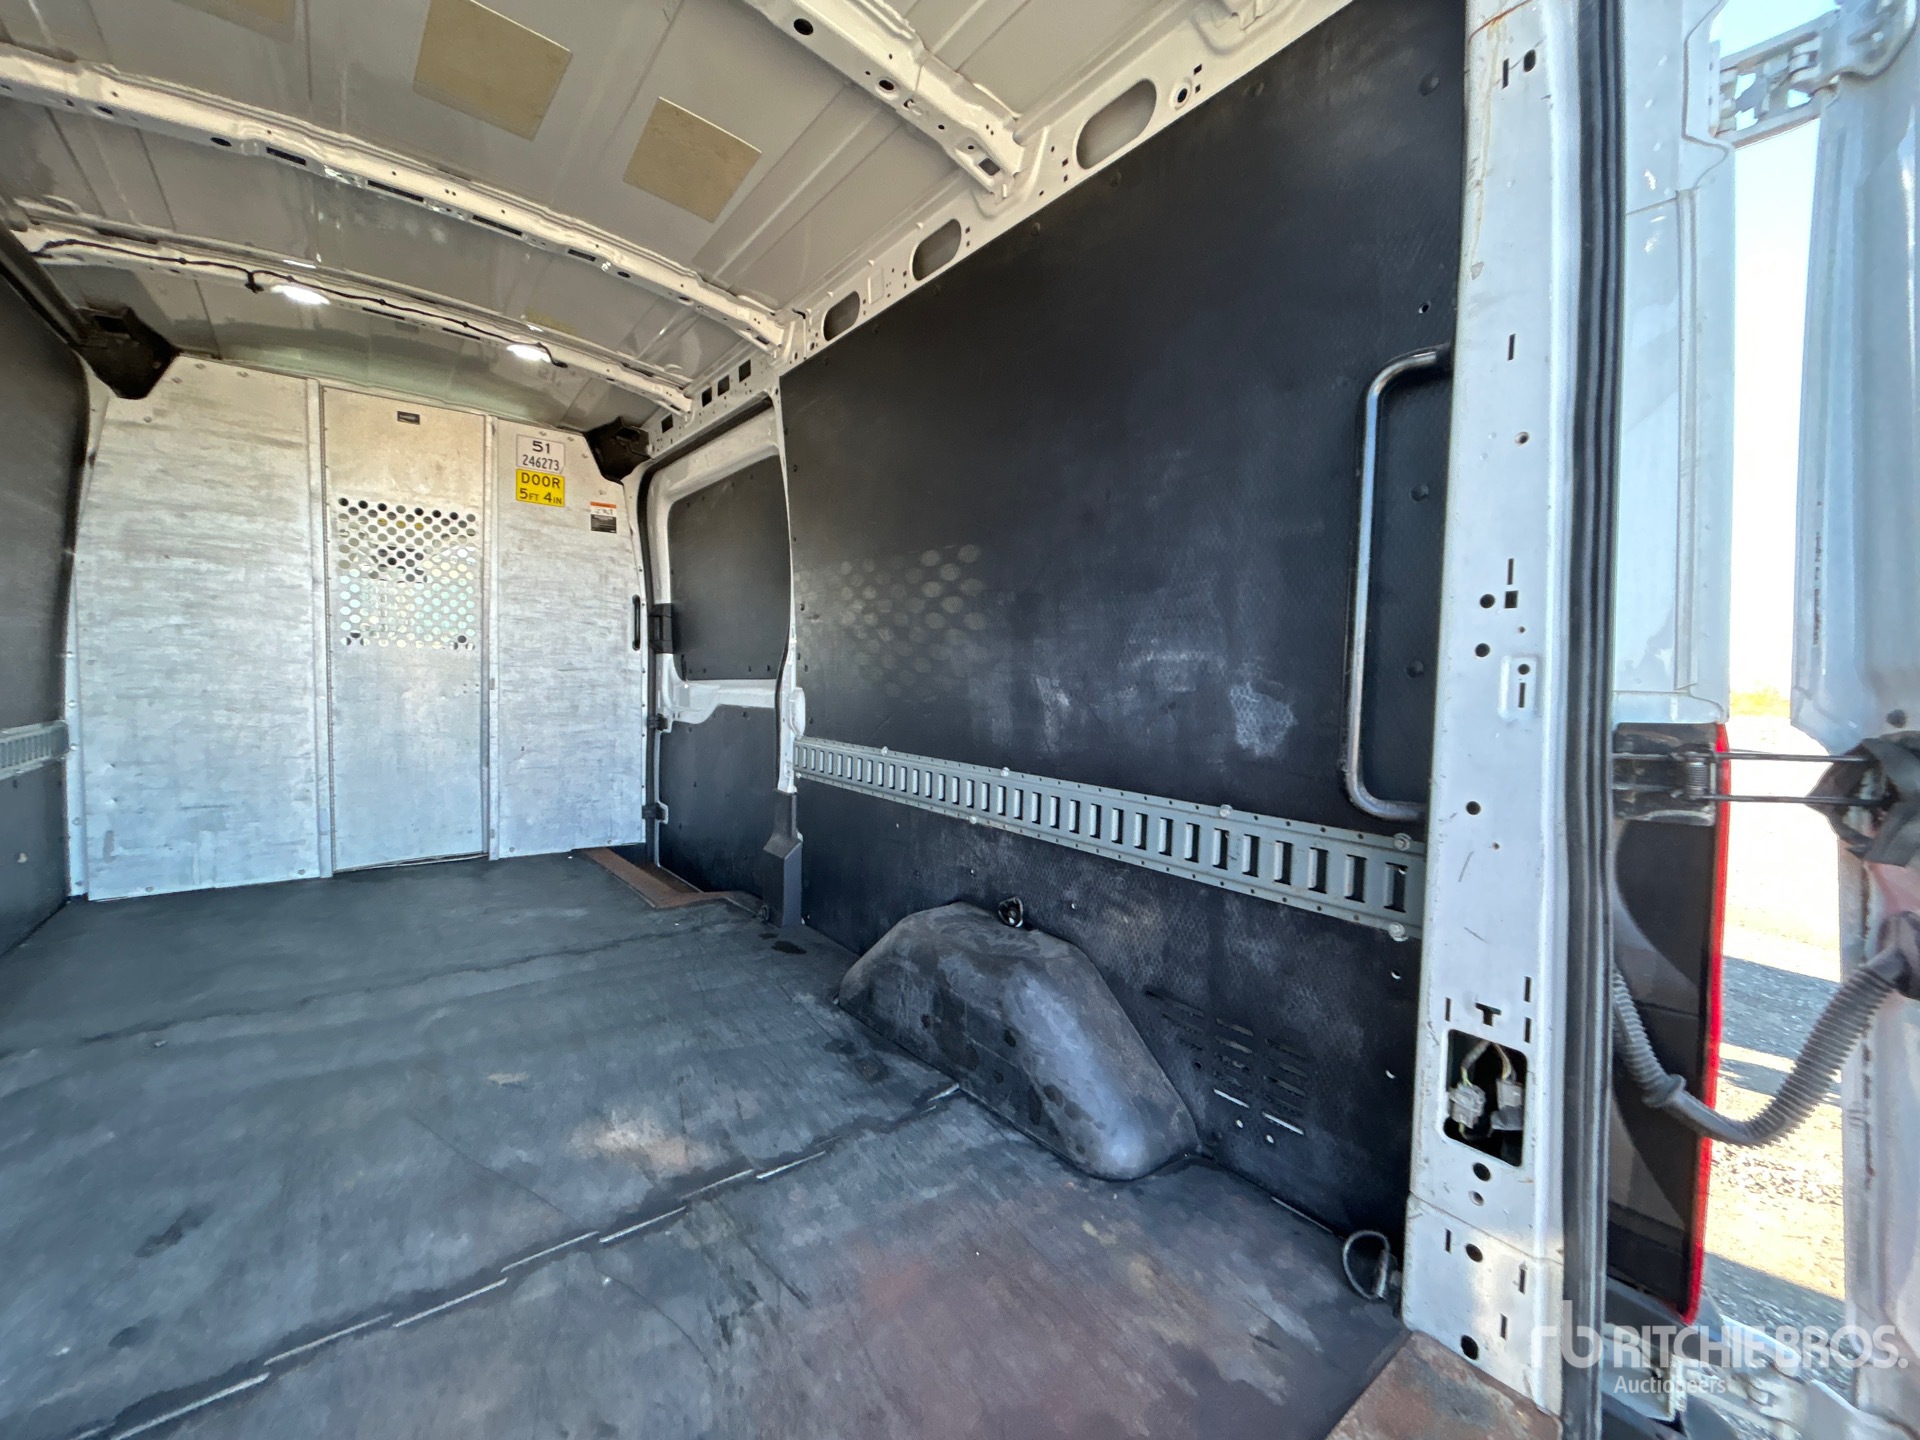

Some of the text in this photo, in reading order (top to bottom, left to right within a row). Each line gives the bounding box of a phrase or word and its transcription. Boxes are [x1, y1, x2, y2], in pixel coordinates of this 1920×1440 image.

[532, 440, 550, 454] 51
[522, 454, 560, 471] 246273
[521, 472, 560, 488] DOOR
